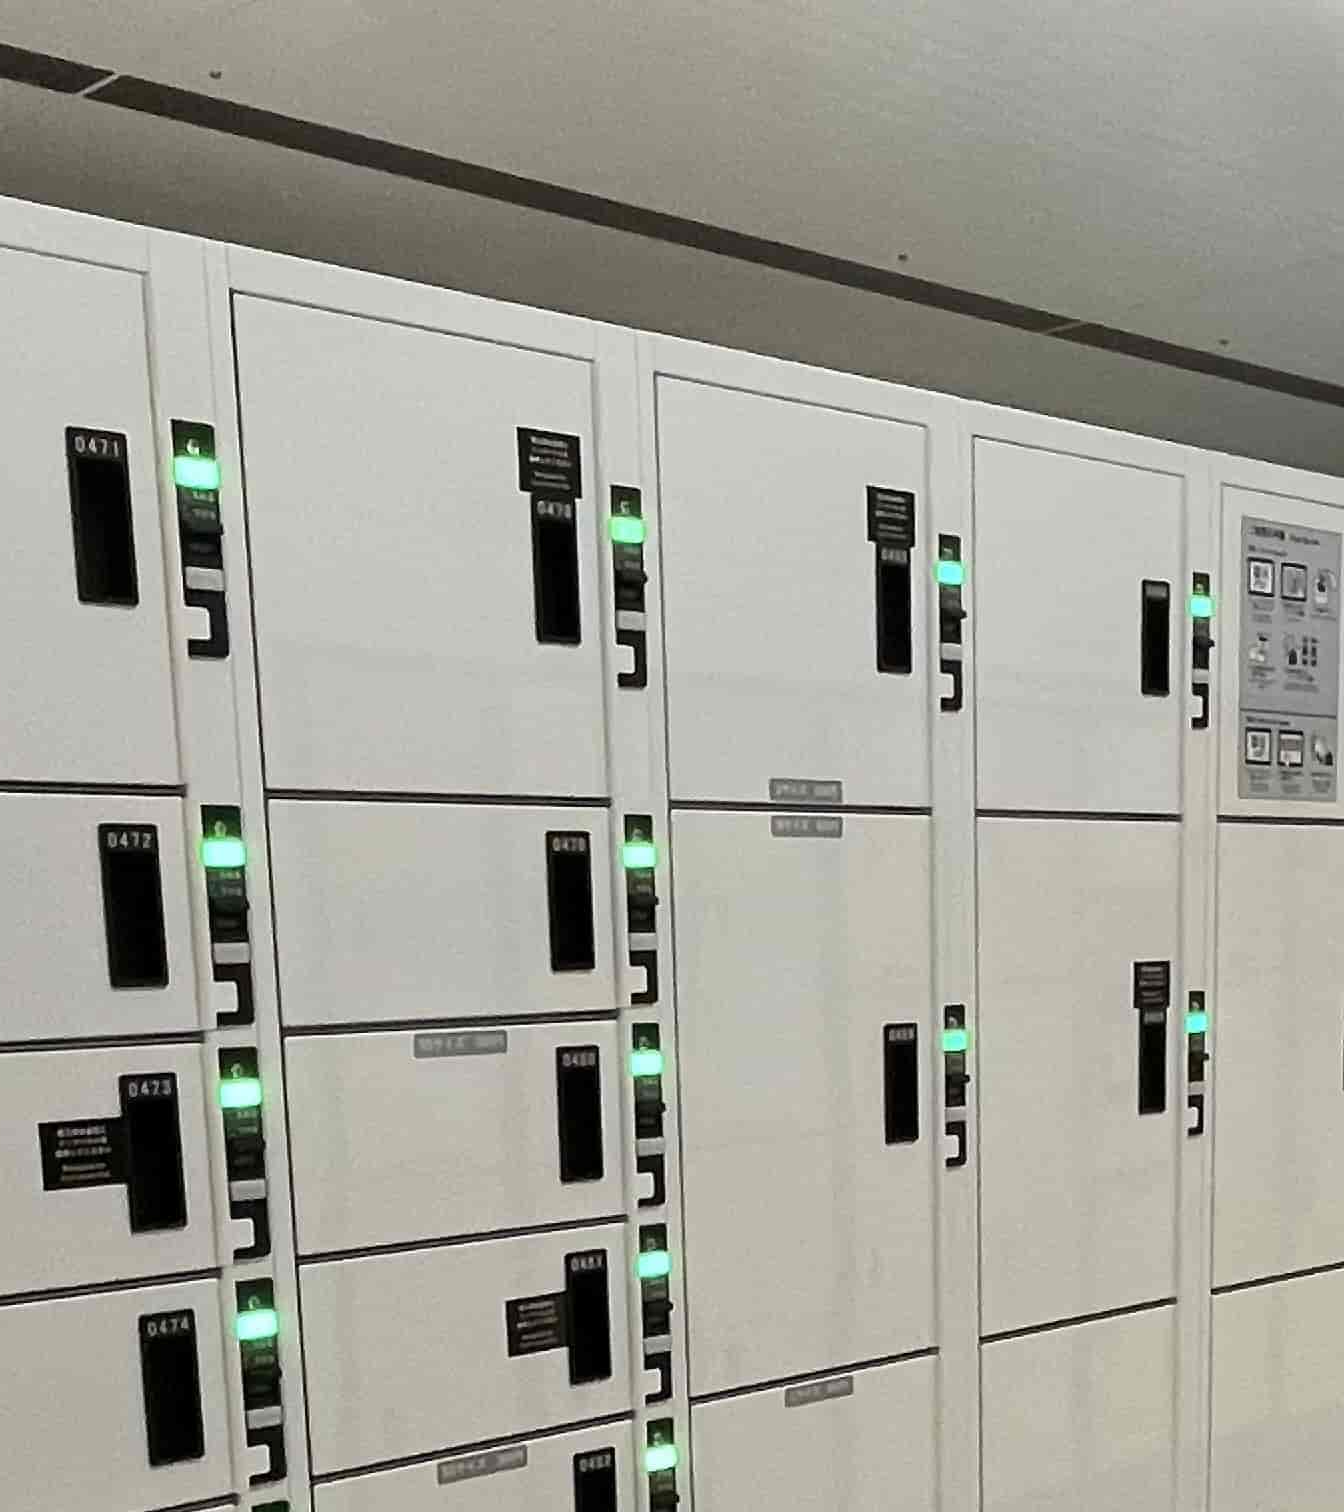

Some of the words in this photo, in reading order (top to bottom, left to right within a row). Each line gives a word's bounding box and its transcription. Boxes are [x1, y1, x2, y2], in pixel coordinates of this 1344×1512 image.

[74, 436, 120, 457] 0471
[107, 832, 153, 849] 0472
[146, 1316, 190, 1337] 0474
